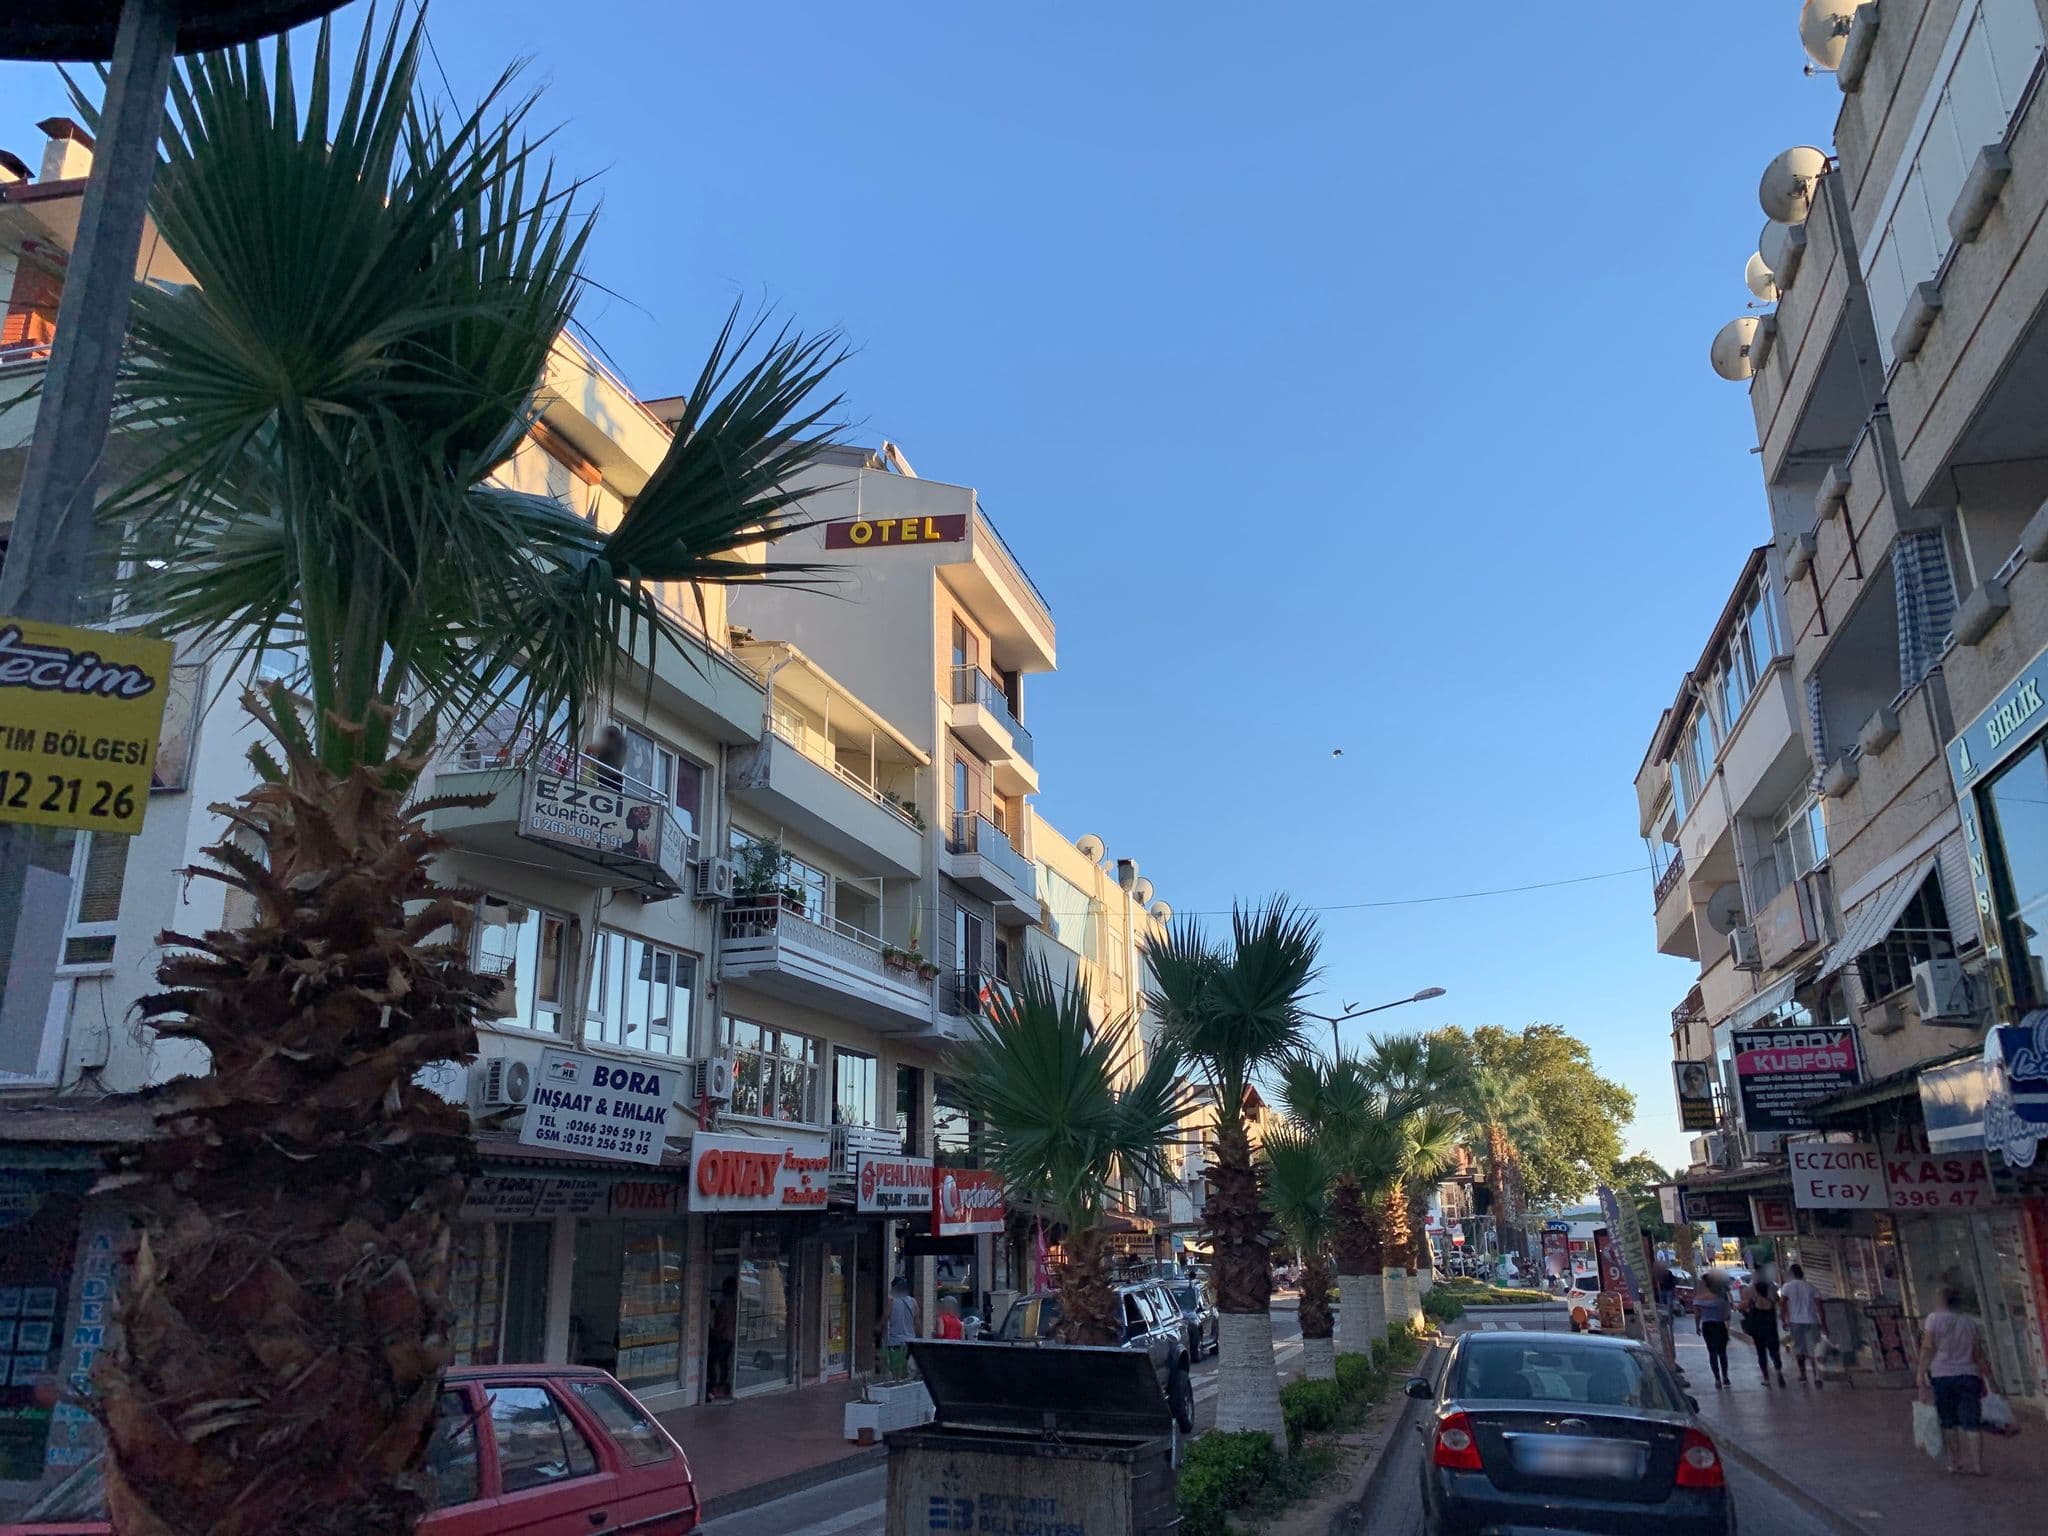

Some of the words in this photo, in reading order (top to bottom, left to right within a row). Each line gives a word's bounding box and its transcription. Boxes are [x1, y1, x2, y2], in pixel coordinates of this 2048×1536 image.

[850, 518, 940, 545] OTEL
[1986, 677, 2045, 750] BİRLİK
[43, 730, 148, 766] BÖLGESİ
[40, 775, 82, 813] 21
[90, 780, 134, 820] 26
[537, 779, 623, 818] EZGİ
[535, 802, 601, 828] KUAFÖR
[532, 817, 540, 829] 0
[543, 819, 566, 834] 266
[568, 825, 591, 838] 396
[611, 836, 624, 848] 91
[592, 1066, 660, 1097] BORA
[532, 1082, 592, 1113] İNŞAAT
[595, 1098, 608, 1115] &
[613, 1100, 667, 1125] EMLAK
[536, 1128, 560, 1142] GSM
[596, 1138, 616, 1150] 256
[619, 1141, 633, 1153] 32
[635, 1144, 649, 1155] 95
[539, 1114, 557, 1128] TEL
[600, 1125, 619, 1137] 396
[622, 1128, 636, 1140] 59
[639, 1131, 652, 1143] 12
[697, 1149, 783, 1199] ONAY
[1810, 1180, 1870, 1202] Eray
[1895, 1191, 1940, 1206] 396
[1949, 1191, 1979, 1206] 47
